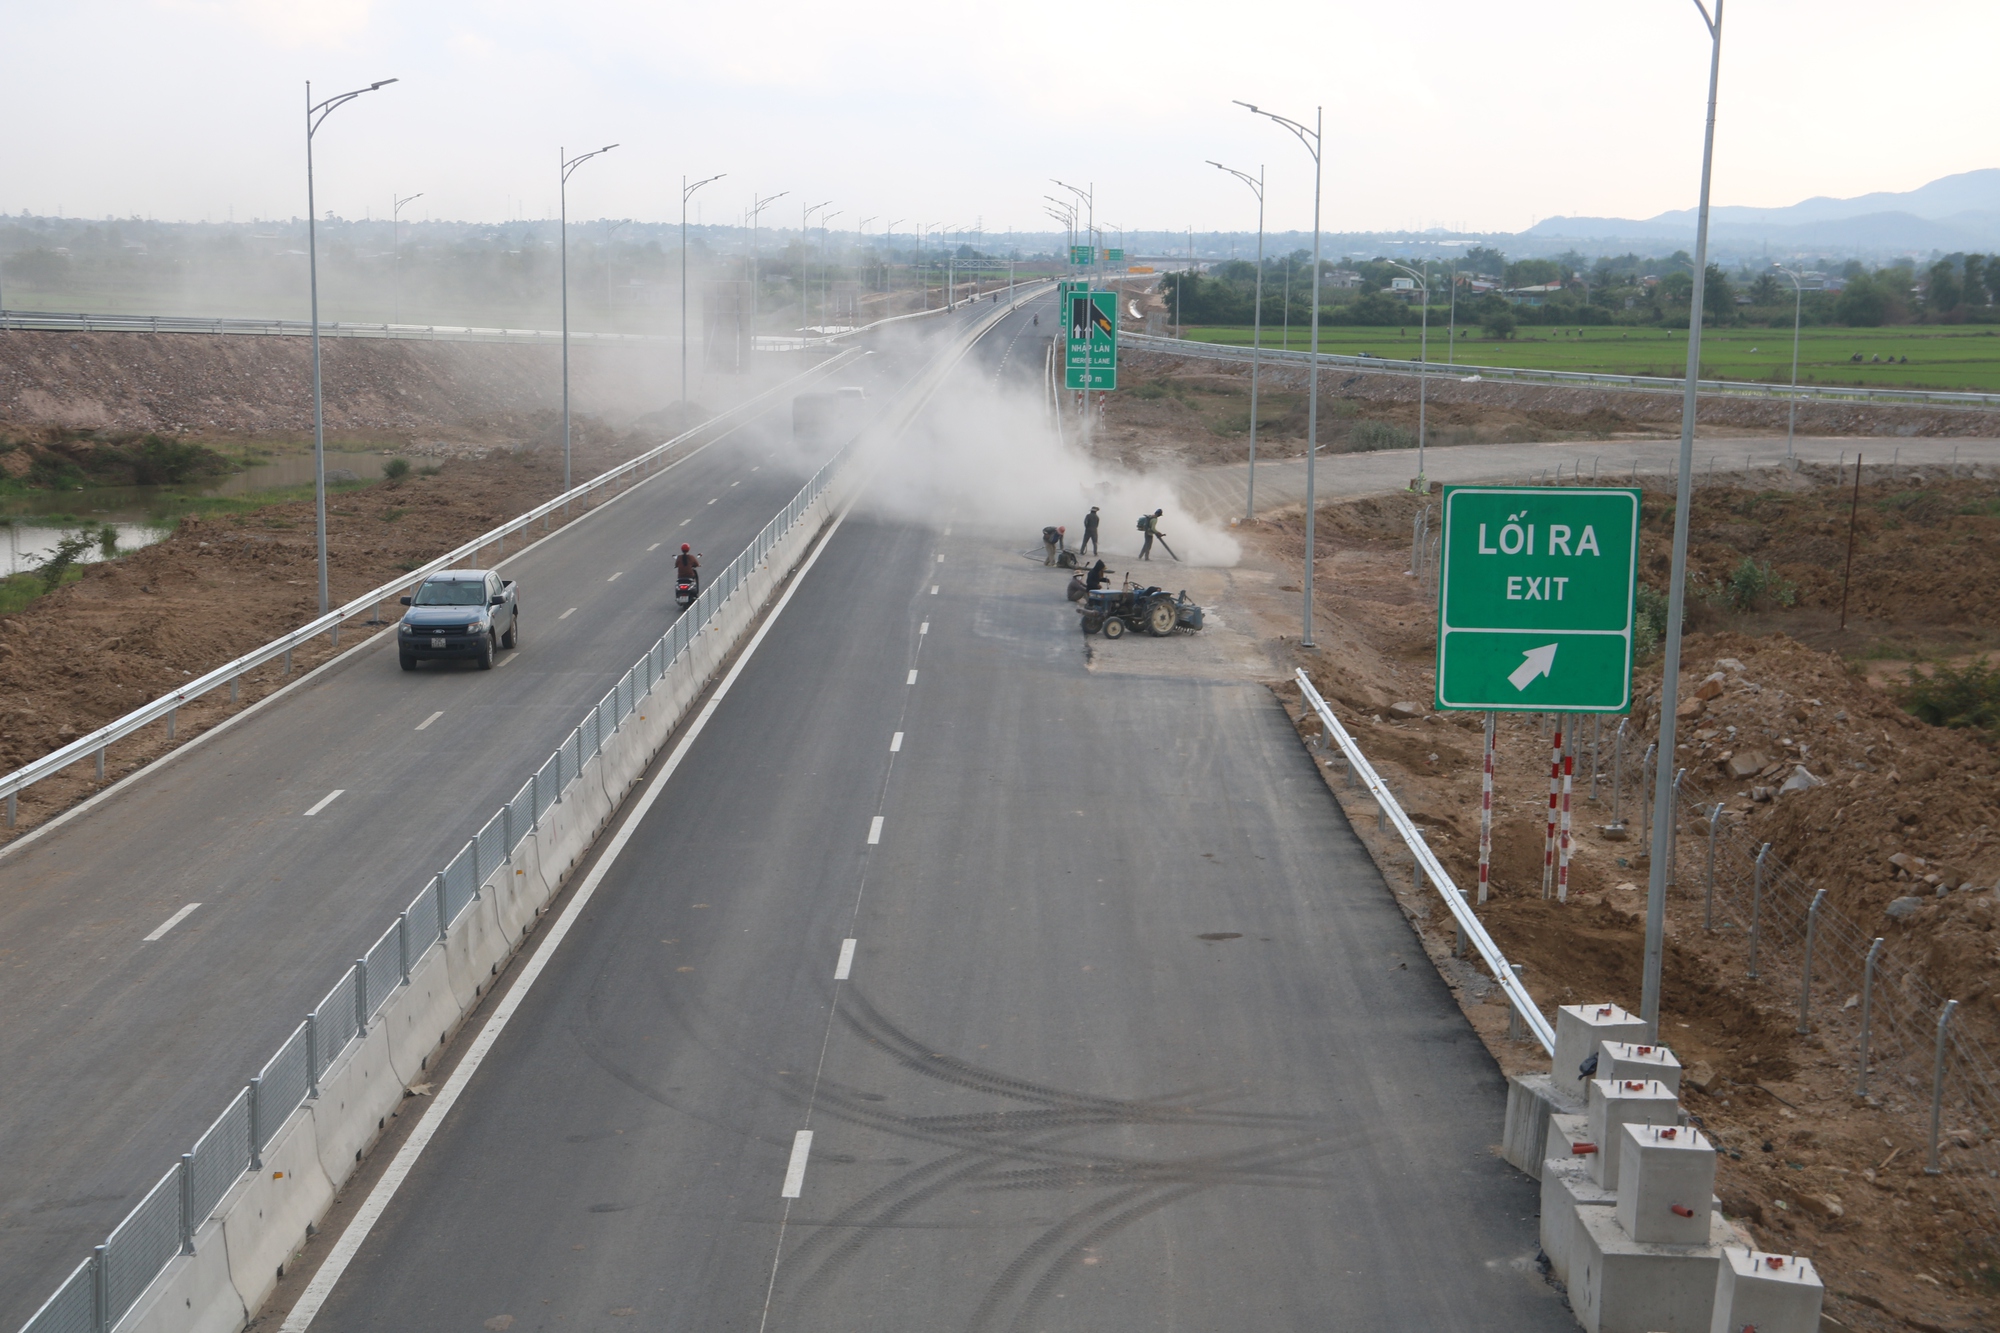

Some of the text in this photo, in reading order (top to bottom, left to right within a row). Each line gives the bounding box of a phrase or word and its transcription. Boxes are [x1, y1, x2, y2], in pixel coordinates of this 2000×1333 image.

[1478, 510, 1600, 556] LỐI RA
[1506, 576, 1569, 601] EXIT
